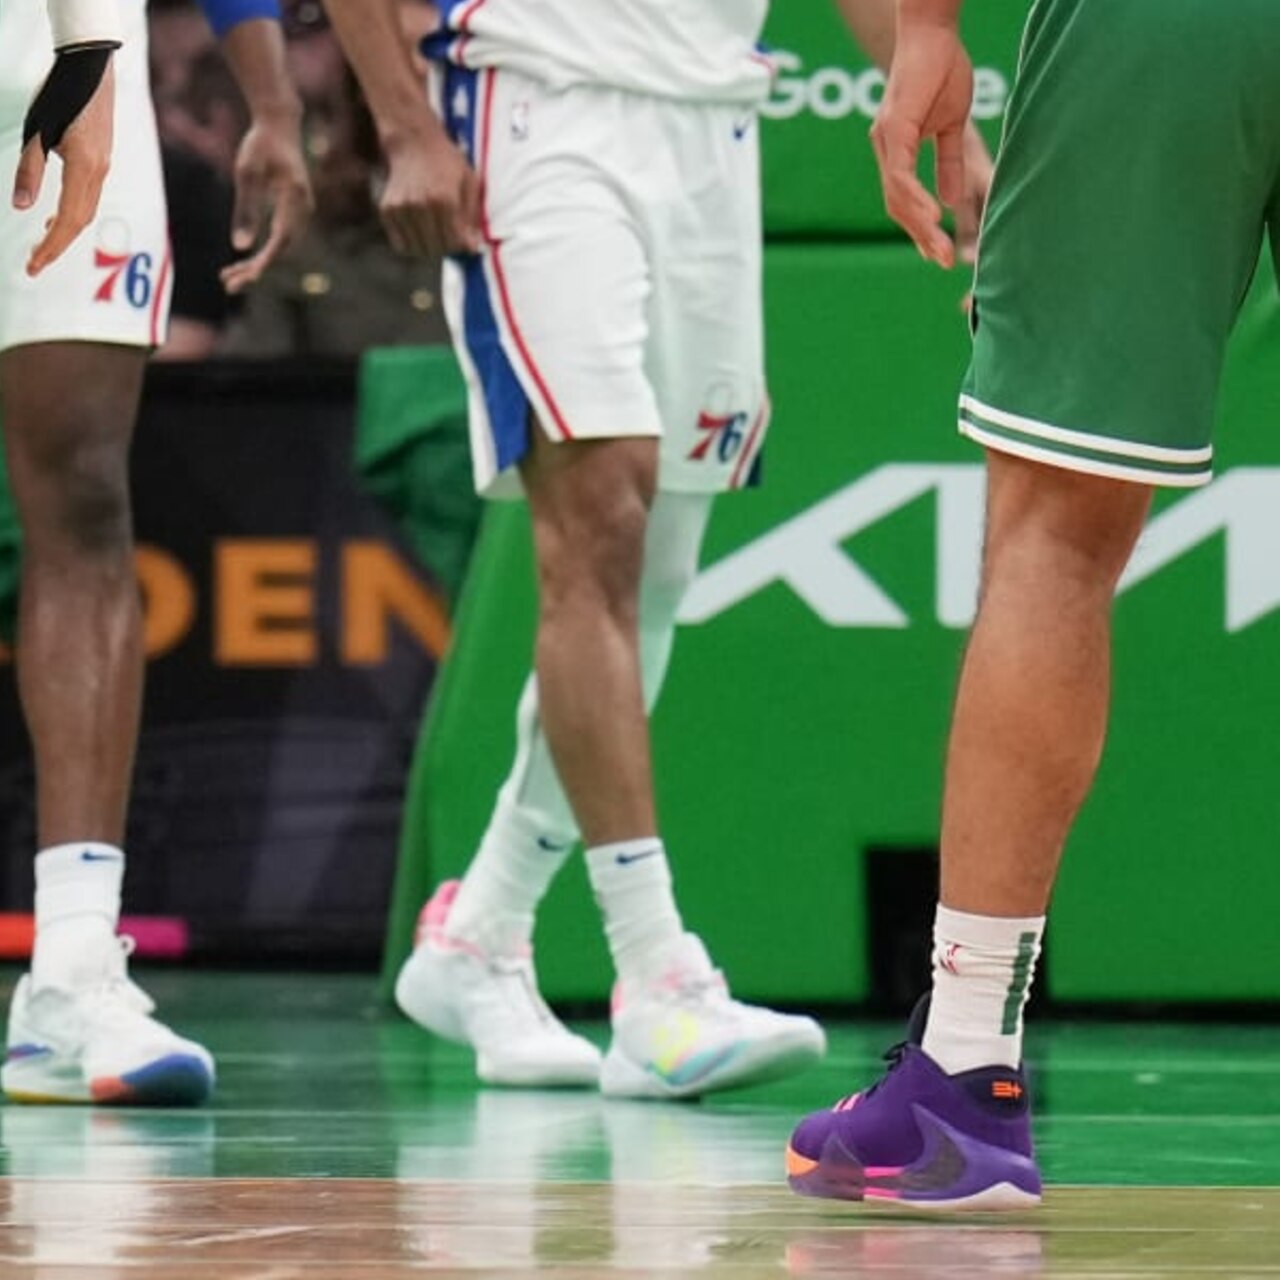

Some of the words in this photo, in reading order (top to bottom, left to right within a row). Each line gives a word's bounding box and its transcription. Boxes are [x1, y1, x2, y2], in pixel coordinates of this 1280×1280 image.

[758, 52, 1006, 120] Gooe
[94, 251, 152, 308] 76
[686, 410, 748, 465] 76
